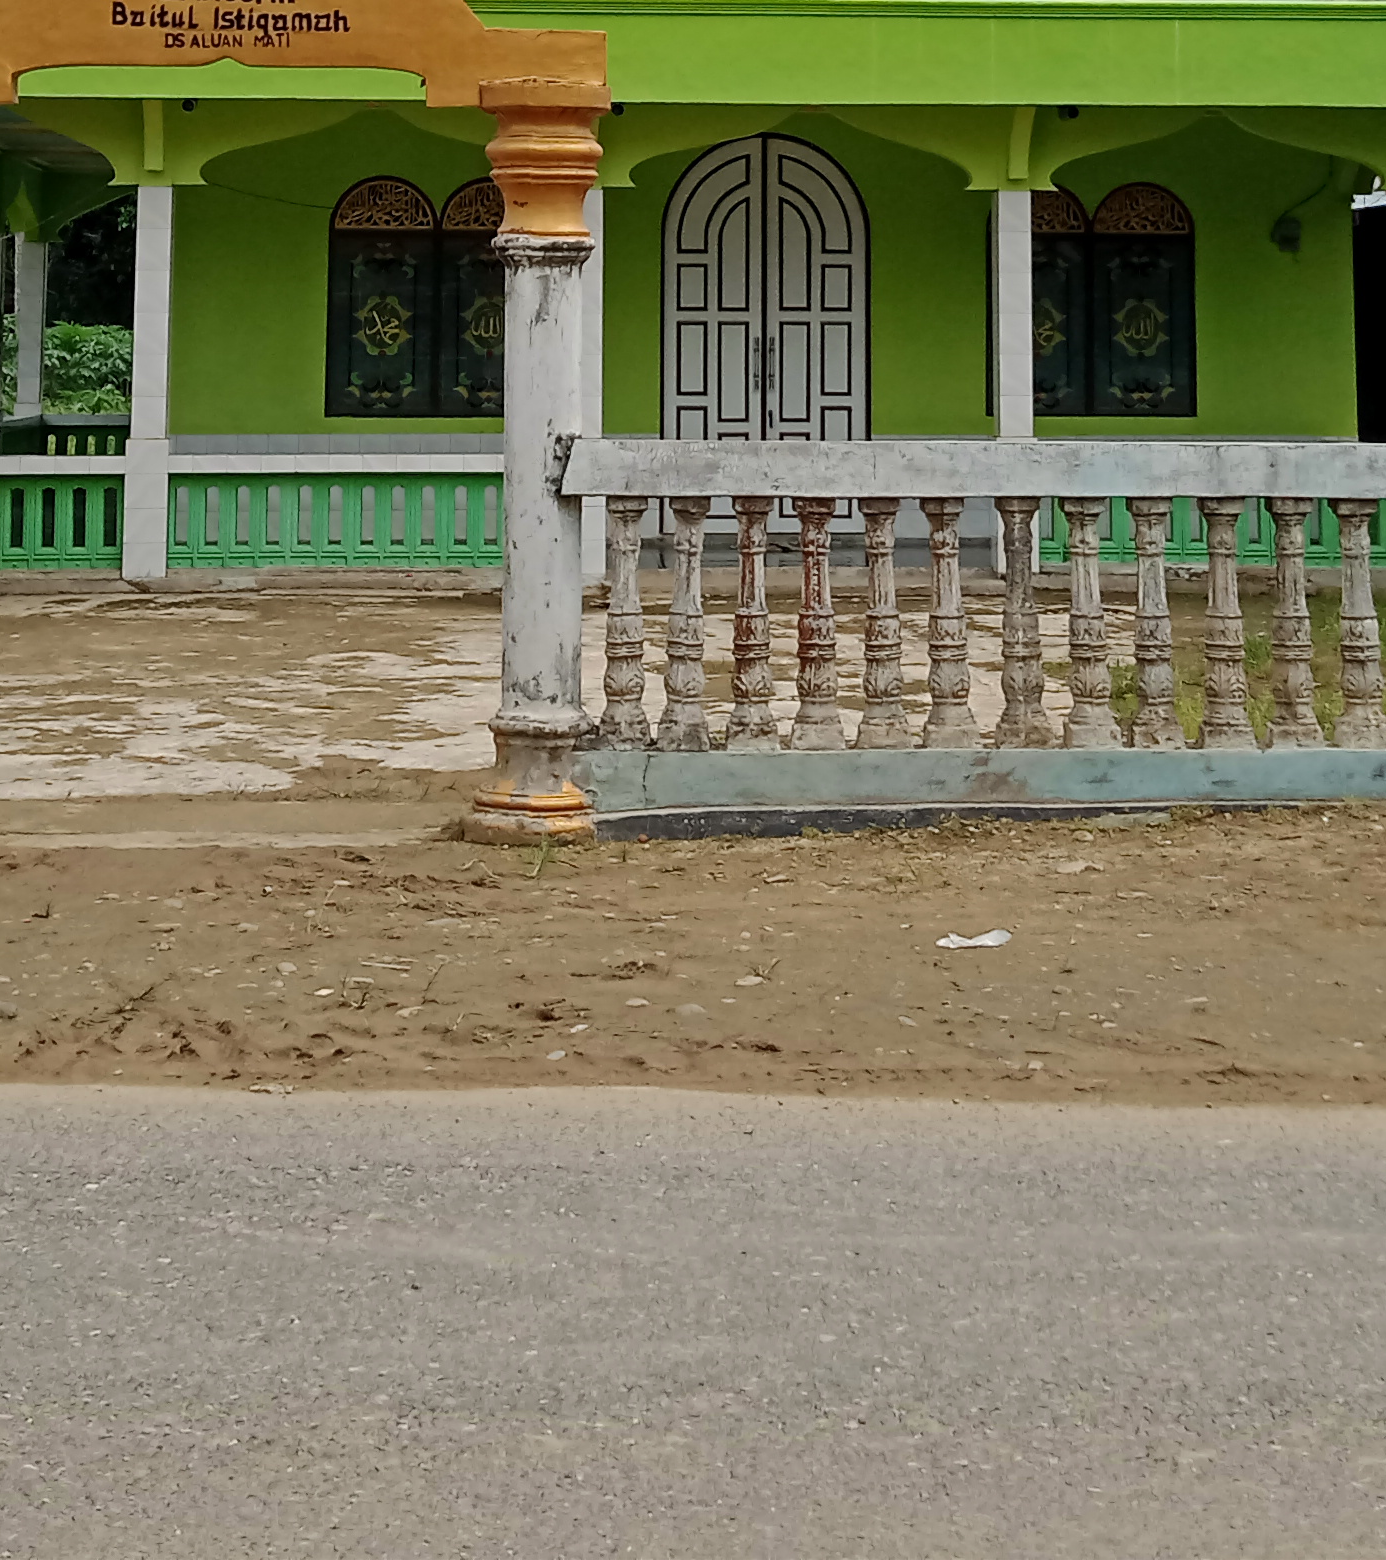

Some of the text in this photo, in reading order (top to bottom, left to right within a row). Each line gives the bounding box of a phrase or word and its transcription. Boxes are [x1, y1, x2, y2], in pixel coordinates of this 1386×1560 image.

[213, 6, 351, 36] Istiqamah
[164, 32, 291, 49] DS ALUAN MATI
